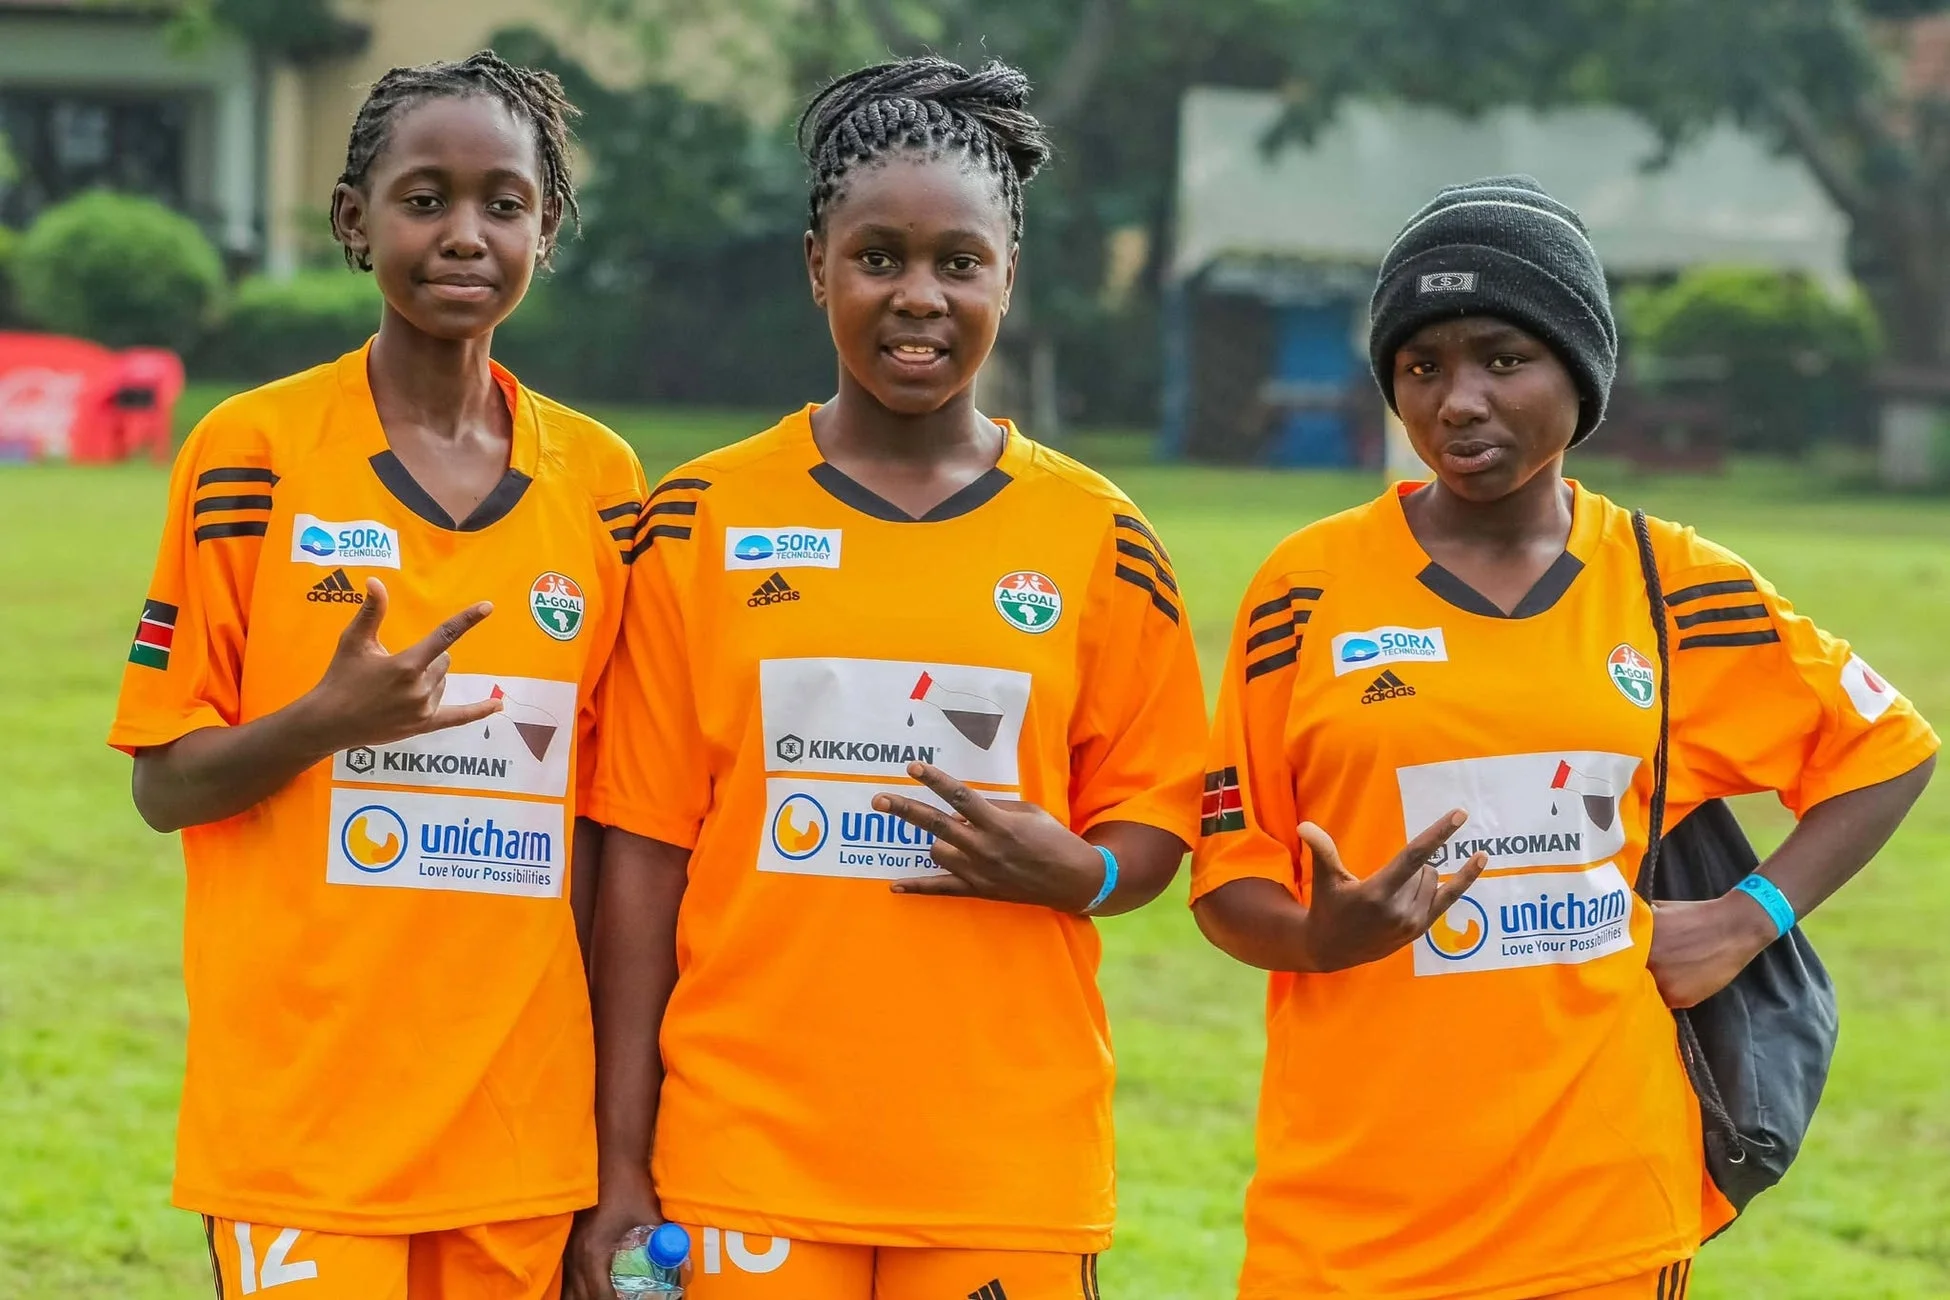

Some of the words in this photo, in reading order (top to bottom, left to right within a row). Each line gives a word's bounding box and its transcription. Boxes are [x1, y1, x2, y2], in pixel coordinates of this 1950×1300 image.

[338, 528, 391, 551] SORA
[776, 534, 830, 553] SORA
[338, 549, 391, 559] TECHNOLOGY
[776, 551, 831, 560] TECHNOLOGY
[306, 590, 364, 604] adidas
[535, 592, 581, 612] A-GOAL
[747, 590, 800, 608] adidas
[999, 588, 1057, 608] A-GOAL
[1380, 633, 1435, 650] SORA
[1382, 647, 1436, 657] TECHNOLOGY
[1361, 686, 1416, 705] adidas
[808, 740, 934, 765] KIKKOMAN
[383, 751, 507, 778] KIKKOMAN
[841, 811, 934, 845] unic
[420, 817, 551, 862] unicharm
[1454, 833, 1581, 860] KIKKOMAN
[839, 851, 874, 865] Love
[878, 853, 911, 867] Your
[419, 863, 448, 877] Love
[451, 864, 480, 880] Your
[483, 867, 551, 886] Possibilities
[1500, 889, 1625, 934] unicharm
[1502, 943, 1533, 956] Love
[1536, 940, 1566, 953] Your
[234, 1221, 318, 1295] 12
